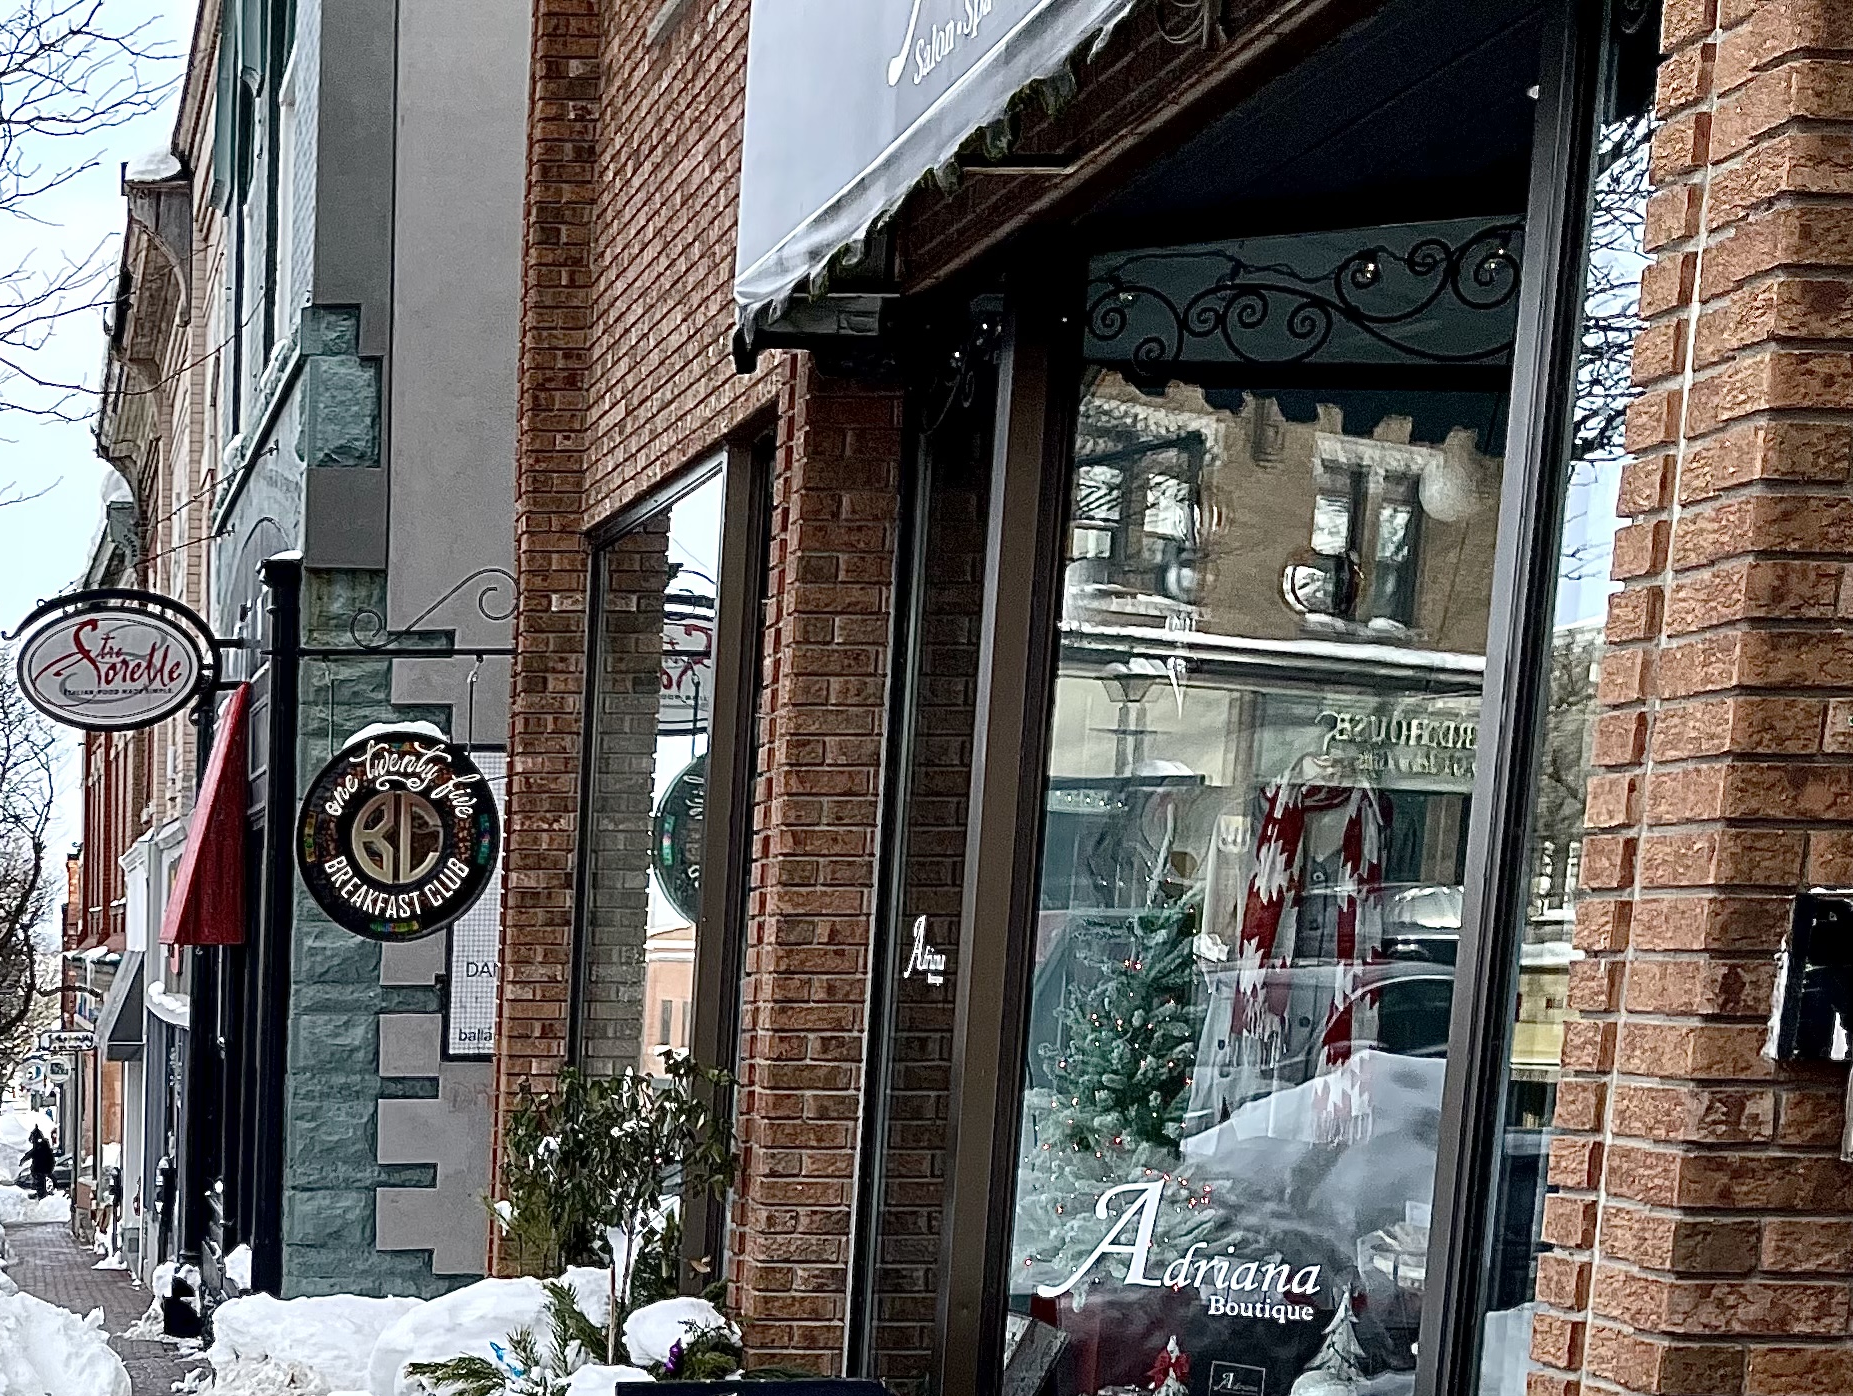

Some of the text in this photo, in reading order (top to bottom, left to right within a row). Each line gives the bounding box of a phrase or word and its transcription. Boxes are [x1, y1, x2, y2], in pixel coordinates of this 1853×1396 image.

[912, 19, 954, 85] Salon
[33, 618, 183, 689] Sorelle
[324, 855, 470, 919] BREAKFAST CLUB
[1037, 1178, 1321, 1299] Adriana
[1207, 1296, 1314, 1323] Boutique
